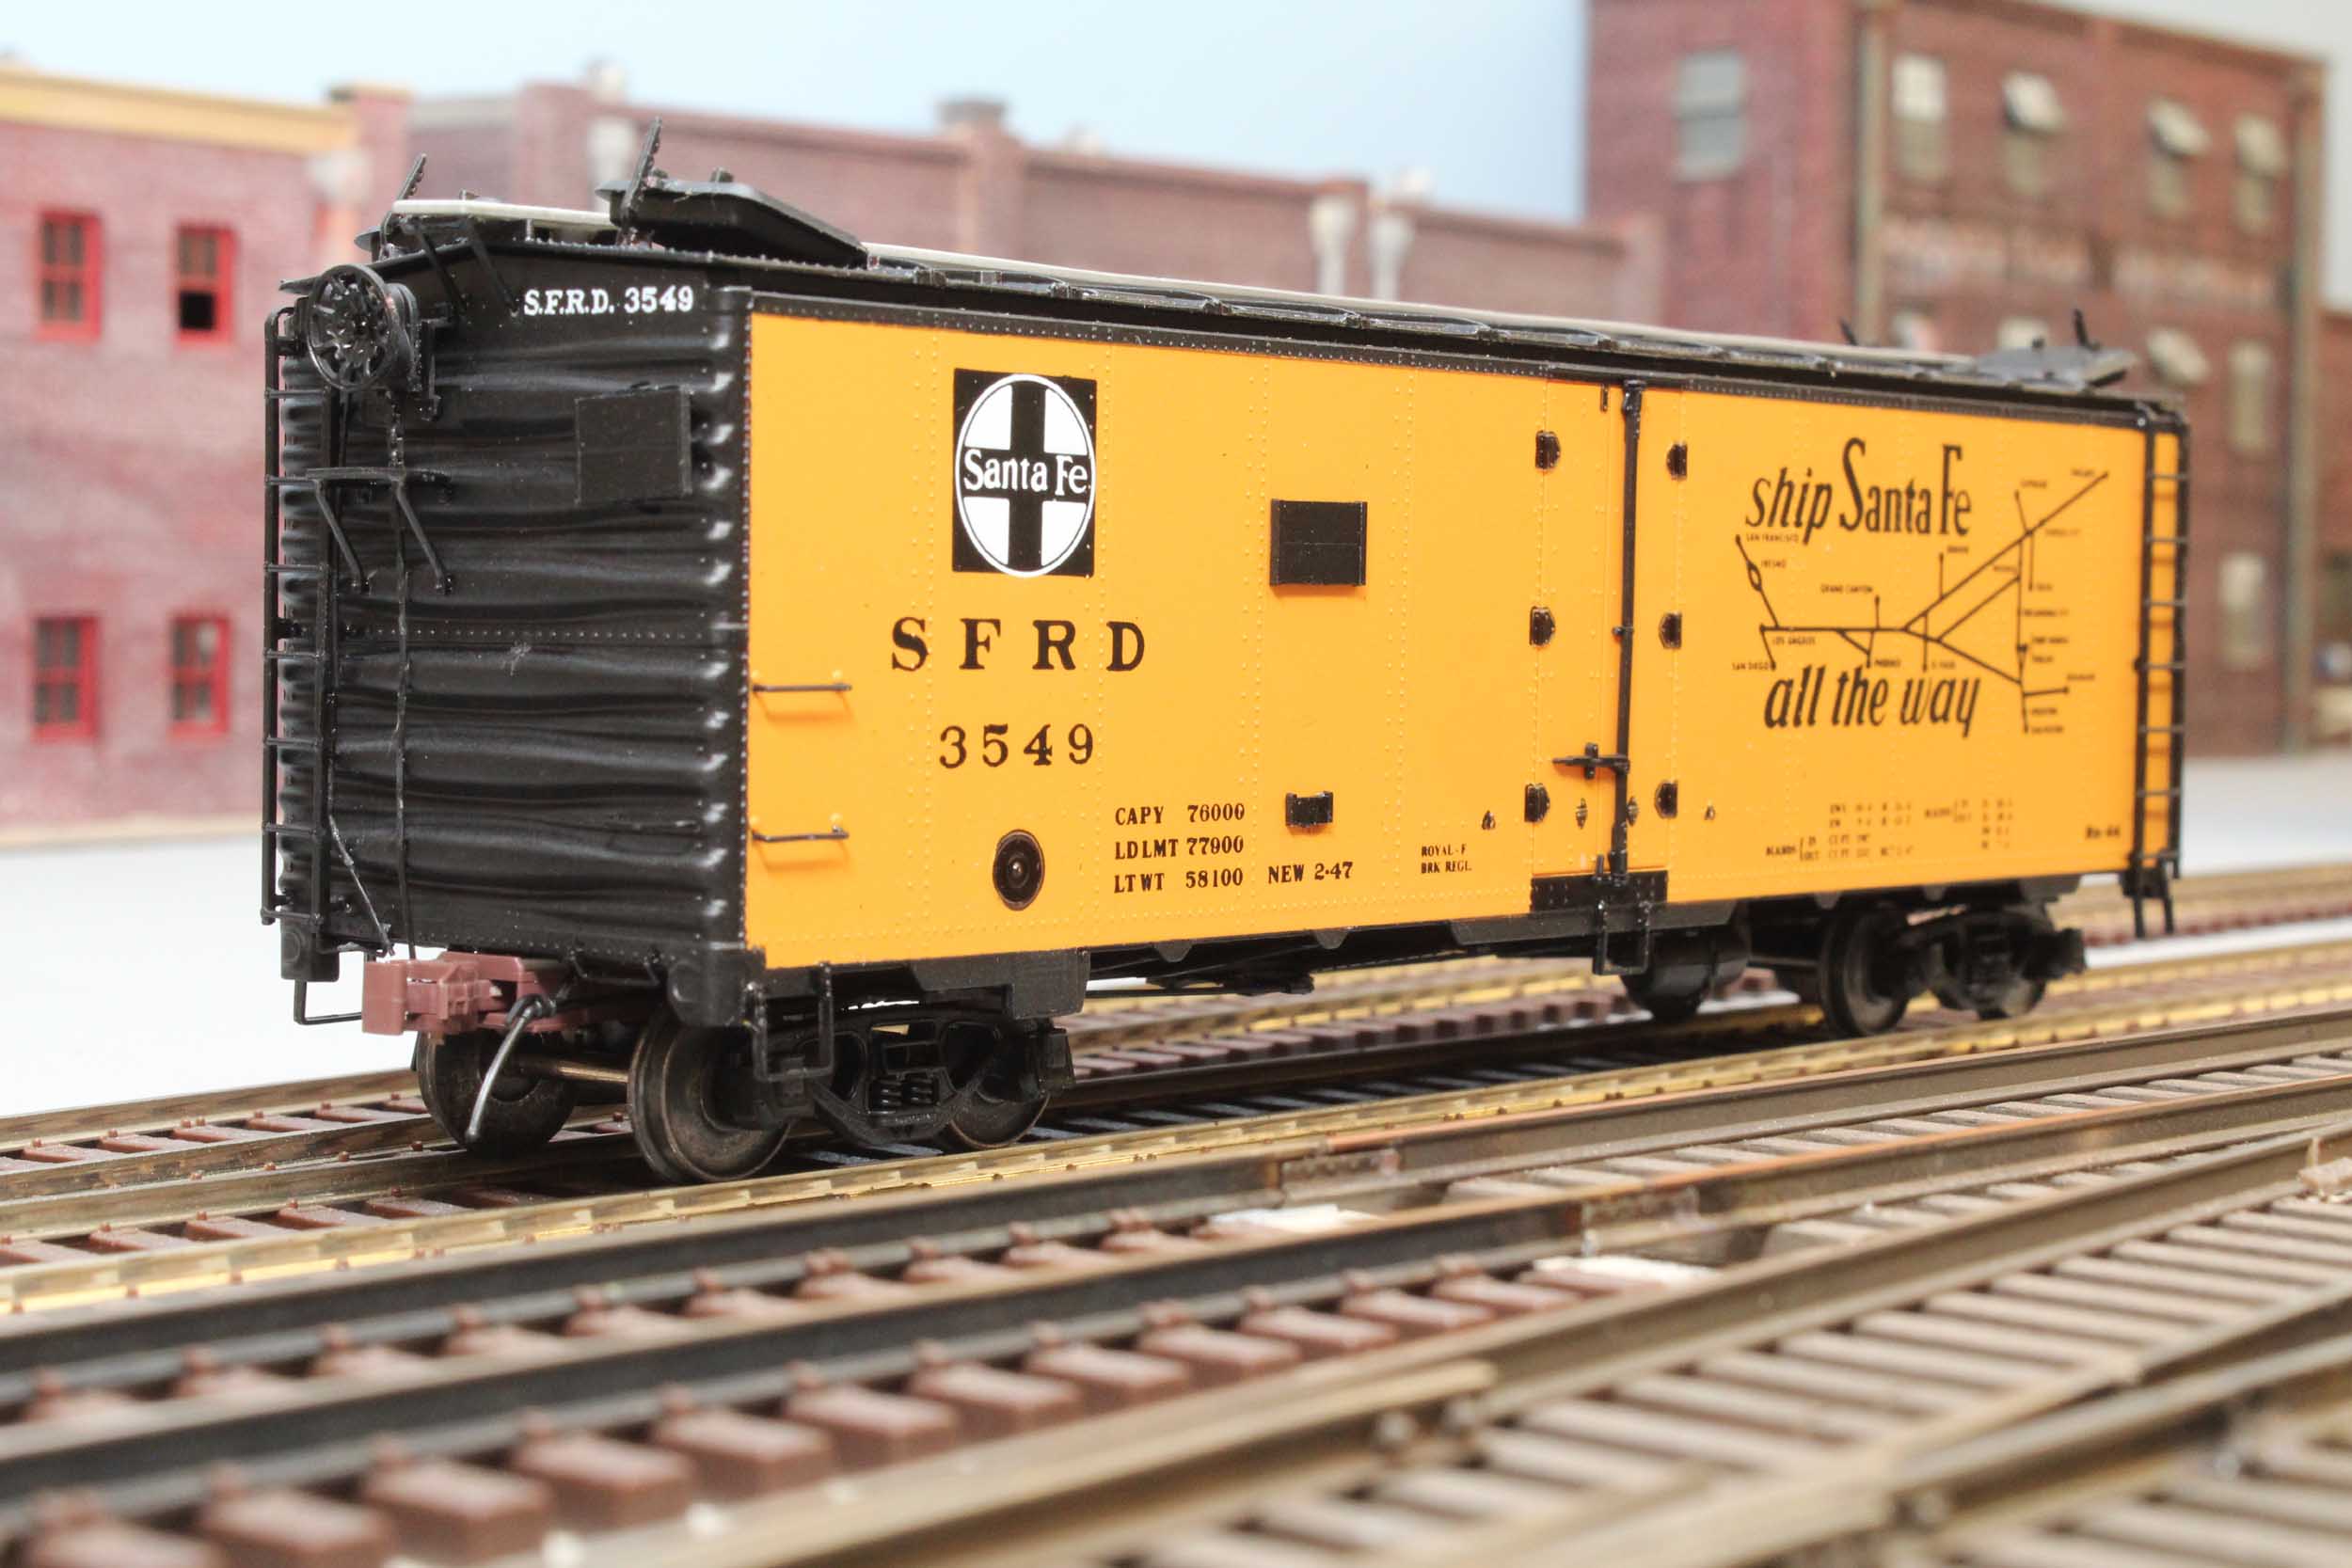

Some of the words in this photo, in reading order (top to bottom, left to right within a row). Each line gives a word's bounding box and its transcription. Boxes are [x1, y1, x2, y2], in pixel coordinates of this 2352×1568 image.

[524, 289, 614, 316] S.F.R.D.
[624, 285, 693, 313] 3549
[963, 448, 1048, 492] Santa
[1055, 454, 1088, 496] Fe
[1745, 467, 1833, 546] ship
[1839, 437, 1931, 534] Santa
[1940, 444, 1971, 536] Fe
[1764, 662, 1825, 728] all
[1832, 662, 1889, 726] the
[1899, 678, 1979, 737] way
[940, 724, 1093, 768] 3549
[1116, 806, 1163, 825] CAPY
[1187, 803, 1245, 822] 76000
[1187, 835, 1243, 855] 77900
[1186, 868, 1243, 888] 58100
[1269, 864, 1304, 883] NEW
